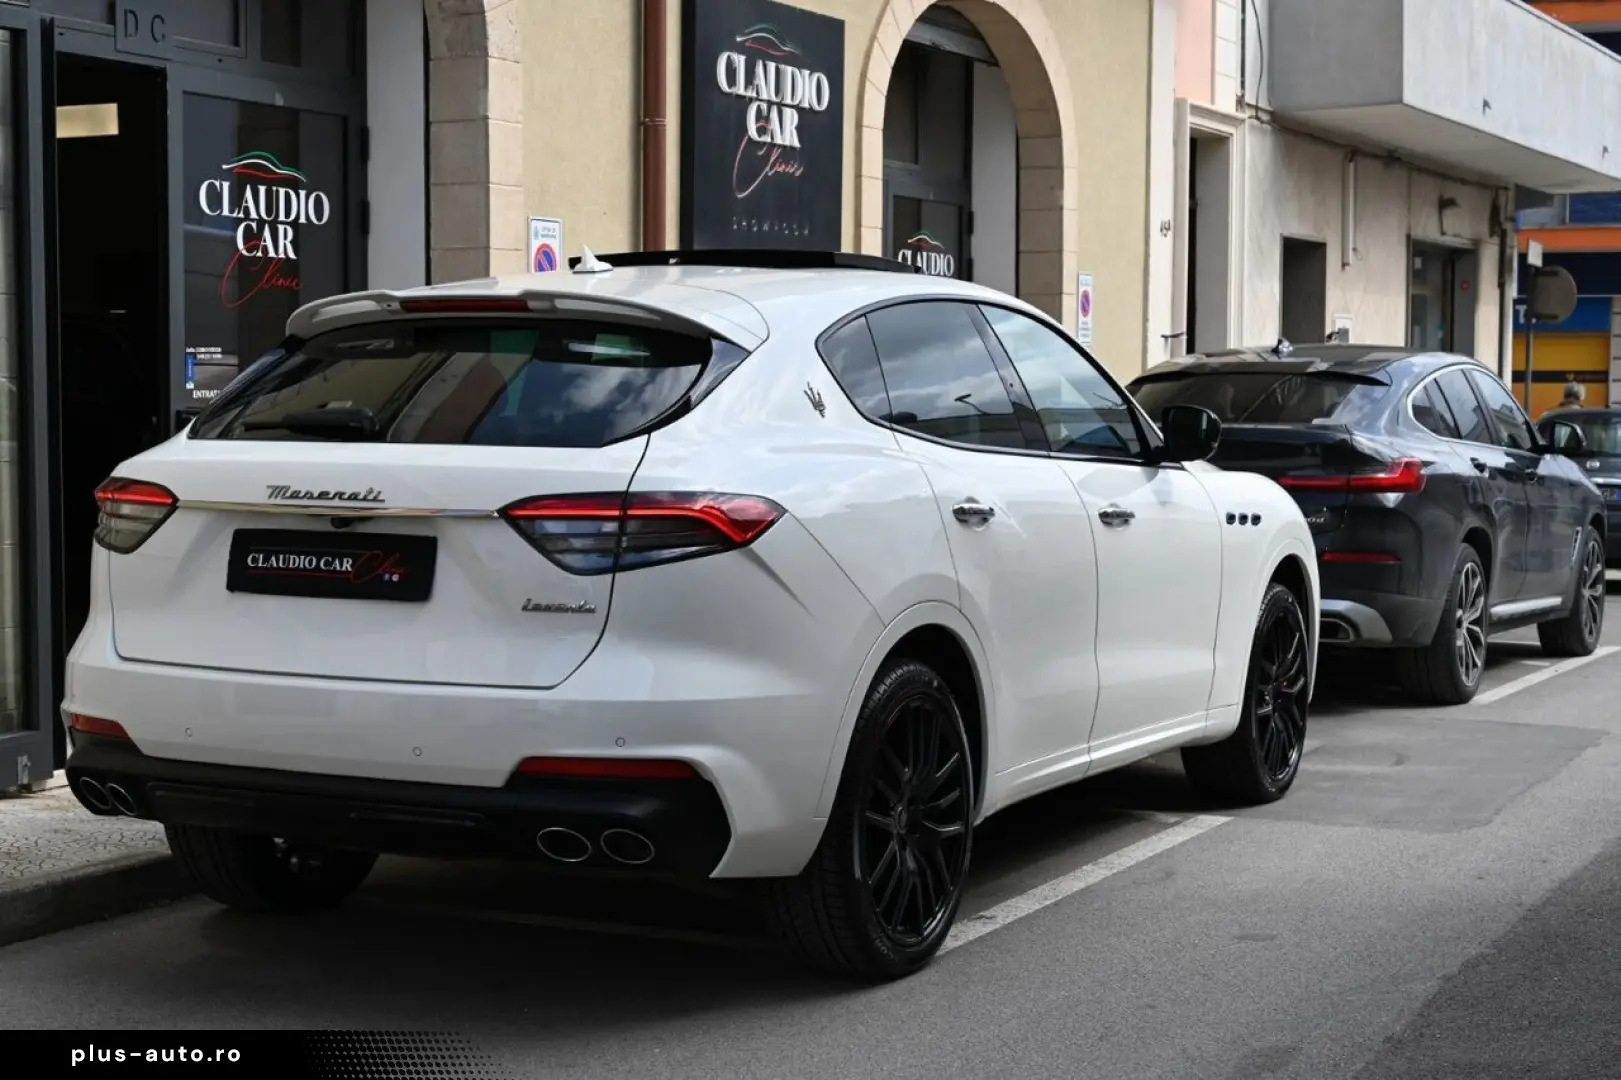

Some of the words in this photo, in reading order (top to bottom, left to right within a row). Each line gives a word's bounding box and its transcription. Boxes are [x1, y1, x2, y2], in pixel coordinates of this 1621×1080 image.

[716, 51, 830, 111] CLAUDIO
[747, 100, 801, 148] CAR
[199, 179, 330, 225] CLAUDIO
[236, 221, 298, 260] CAR
[266, 484, 386, 502] Maserati
[247, 553, 316, 568] CLAUDIO
[319, 556, 353, 571] CAR
